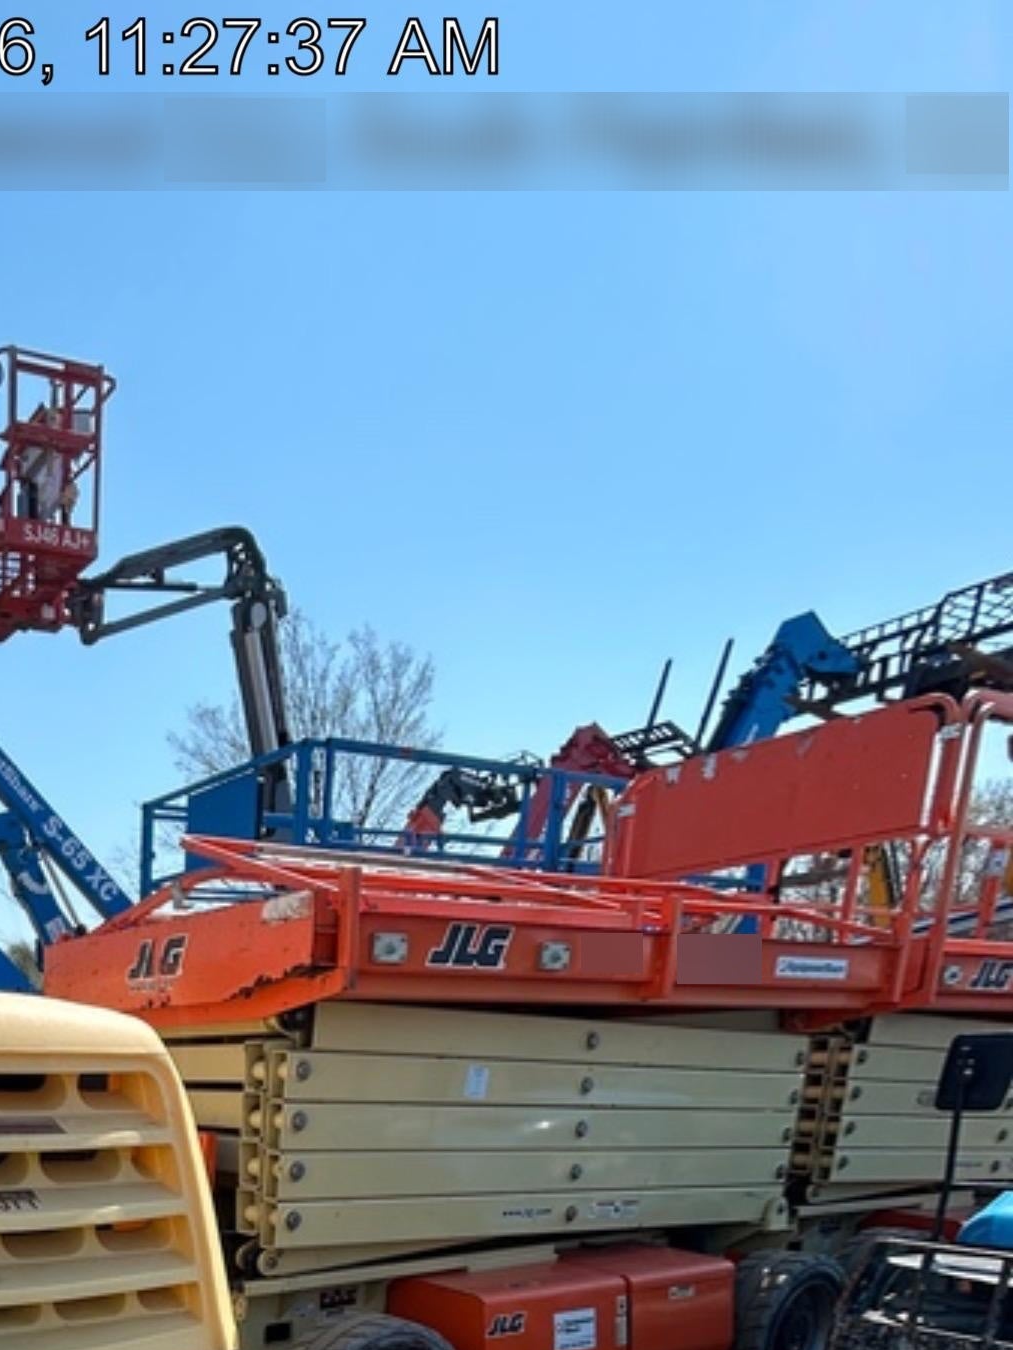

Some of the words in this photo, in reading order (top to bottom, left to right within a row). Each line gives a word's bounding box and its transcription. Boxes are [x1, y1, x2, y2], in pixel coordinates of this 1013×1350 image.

[42, 816, 94, 870] S-65
[85, 866, 117, 901] XC
[425, 920, 516, 970] JLG
[485, 1311, 527, 1338] JLG
